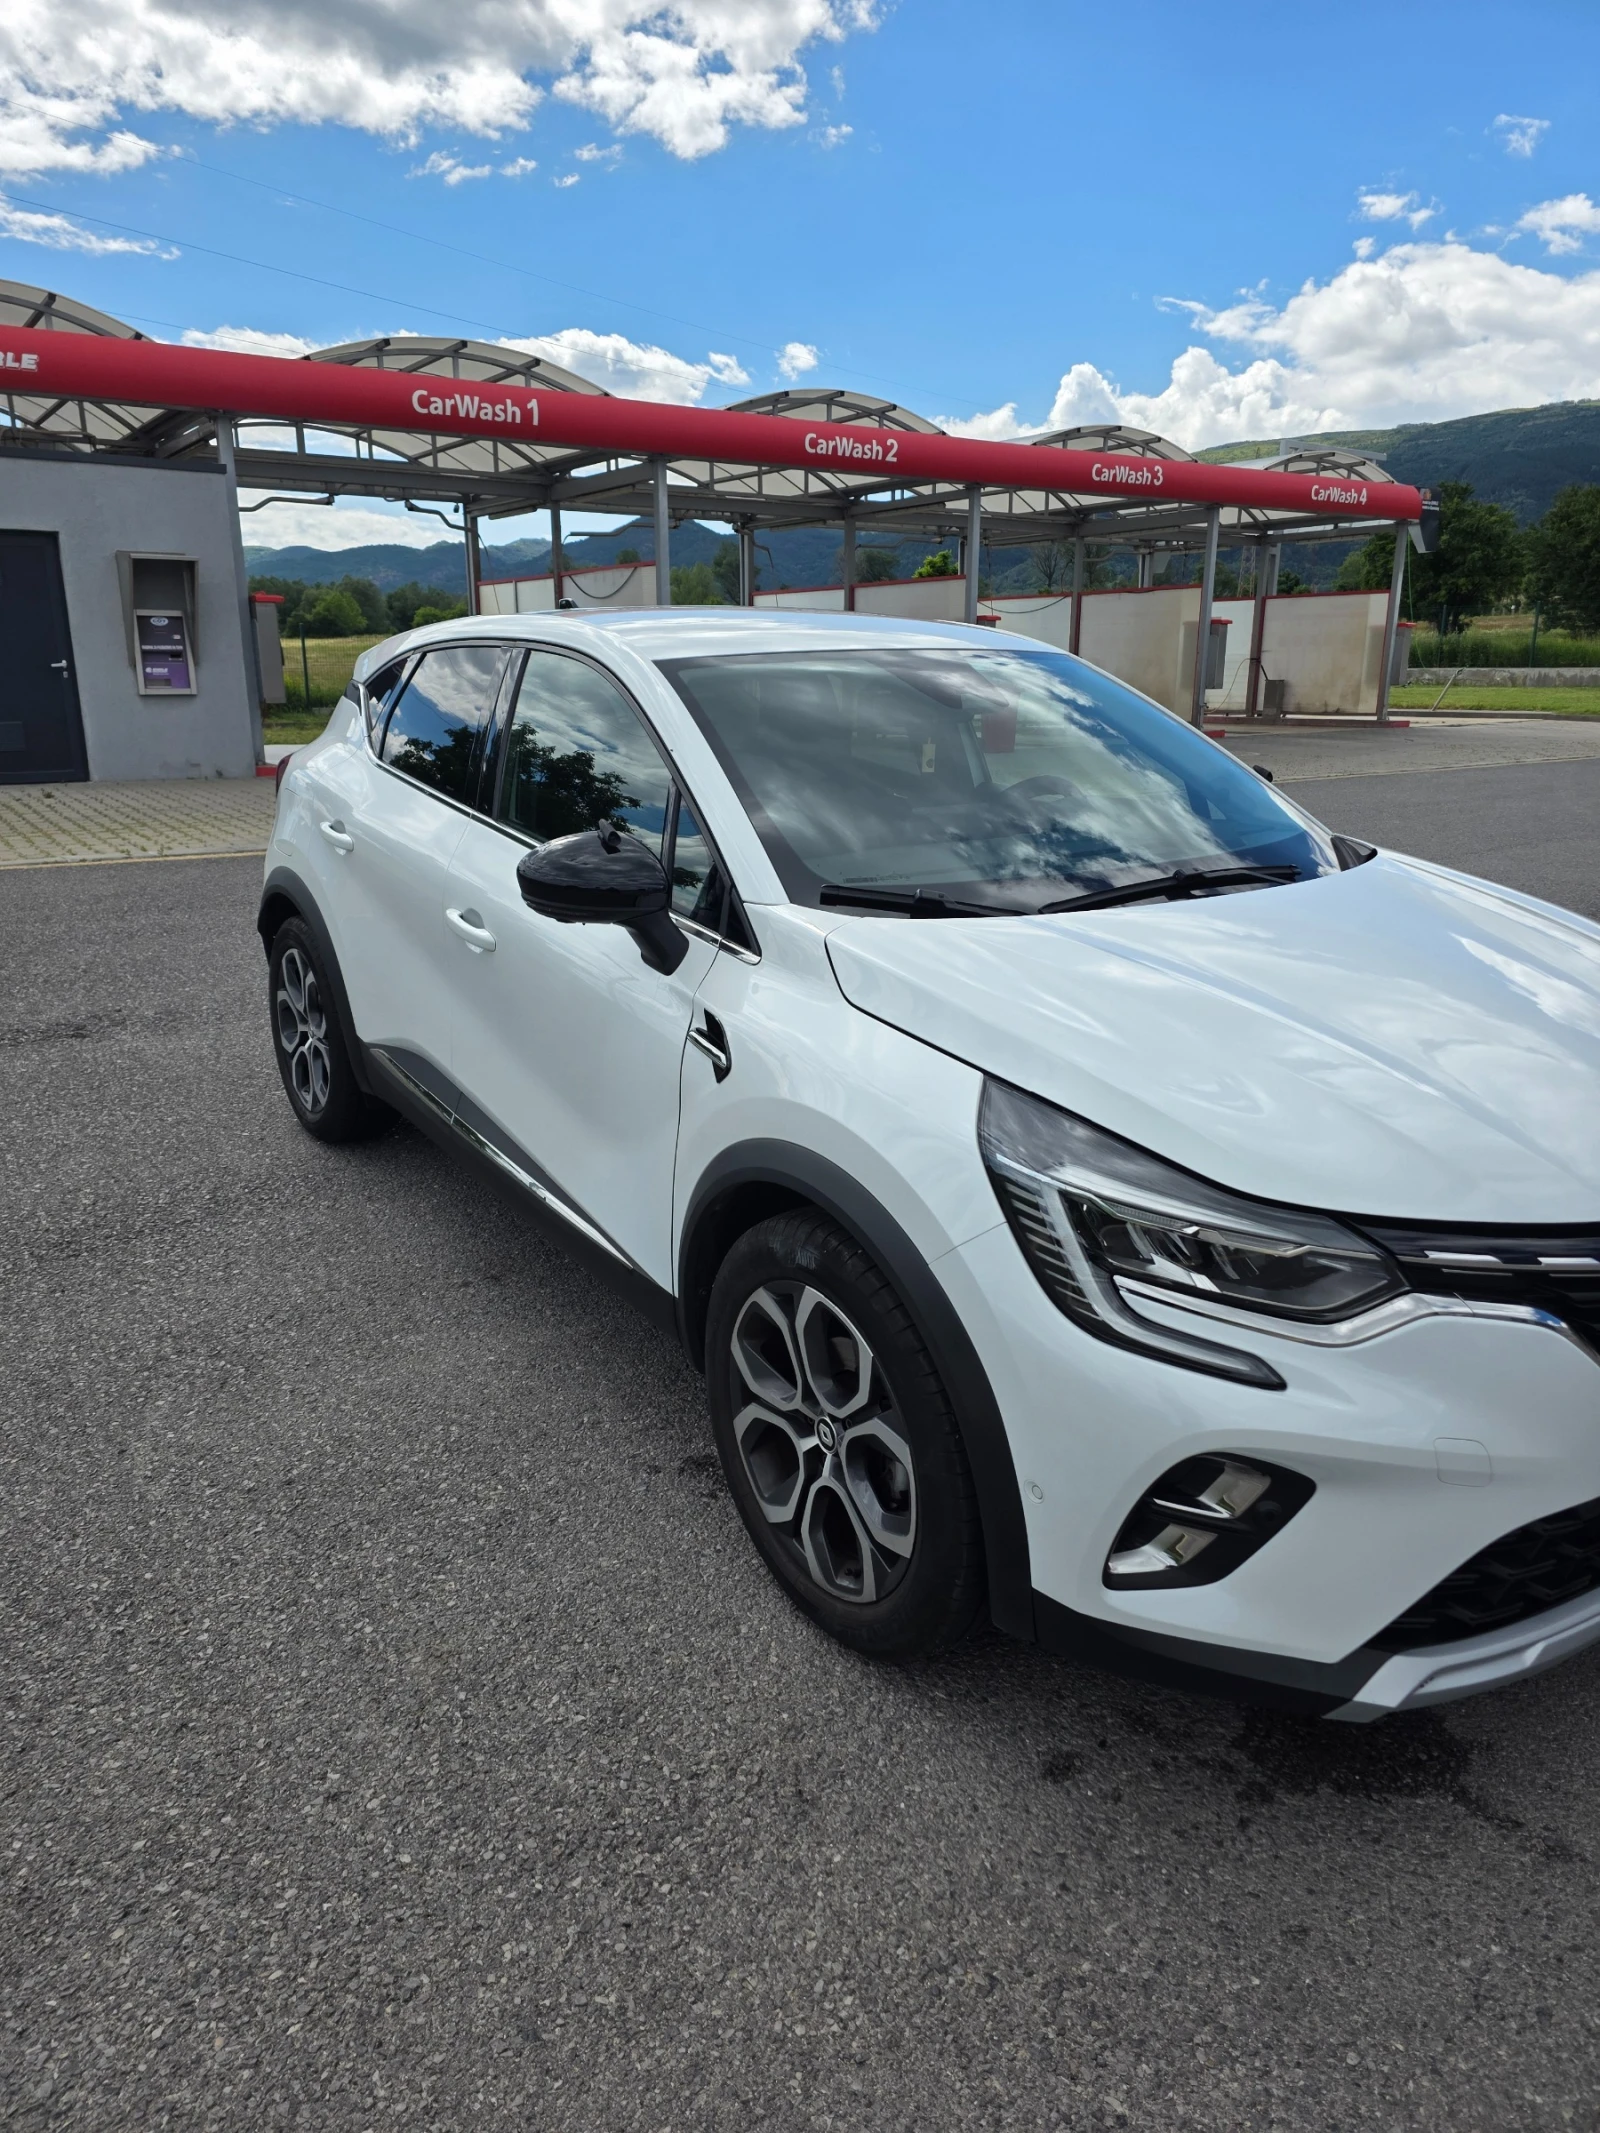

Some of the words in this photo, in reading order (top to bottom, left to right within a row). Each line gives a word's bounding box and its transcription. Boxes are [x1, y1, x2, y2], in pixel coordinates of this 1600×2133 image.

[412, 389, 521, 424] CarWash
[526, 398, 539, 426] 1
[804, 433, 883, 461] CarWash
[885, 438, 899, 462] 2
[1091, 463, 1152, 485] CarWash
[1153, 465, 1163, 486] 3
[1311, 484, 1358, 504] CarWash
[1359, 487, 1367, 505] 4
